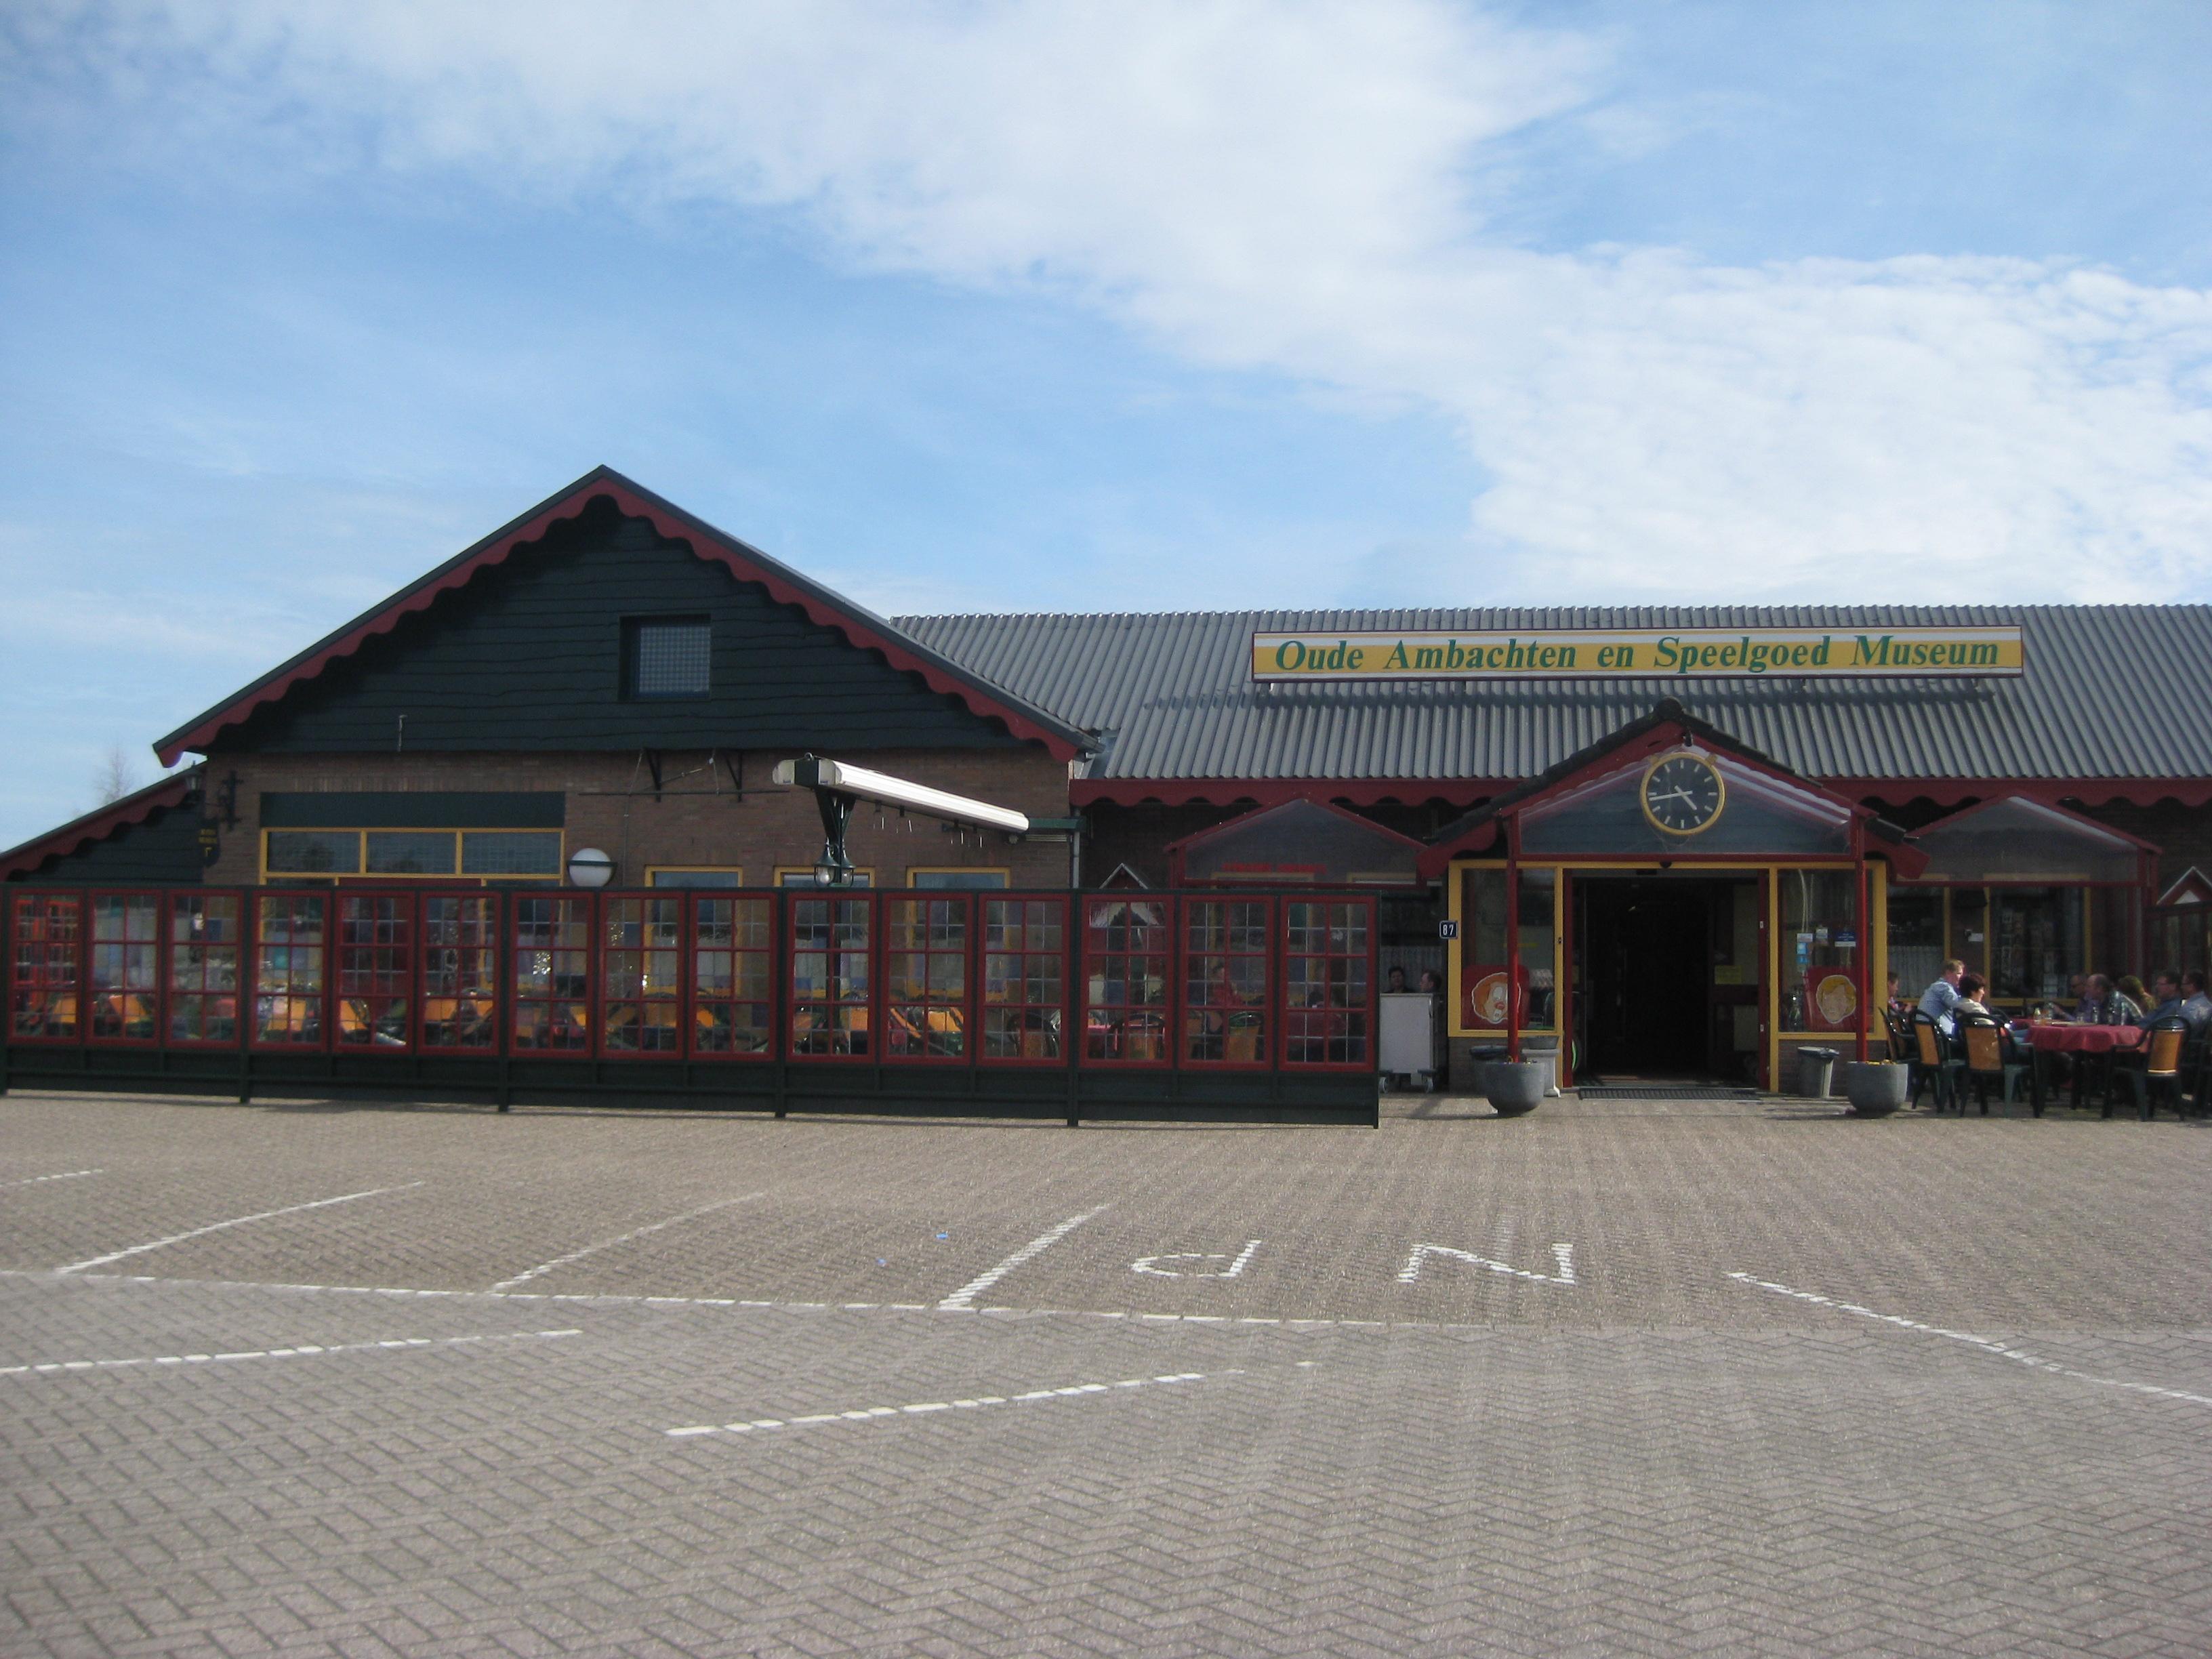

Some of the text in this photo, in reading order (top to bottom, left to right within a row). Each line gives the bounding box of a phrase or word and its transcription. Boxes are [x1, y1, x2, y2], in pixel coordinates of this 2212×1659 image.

[1275, 634, 1999, 674] Oude Ambachten en Speelgoed Museum
[1443, 924, 1454, 936] 87
